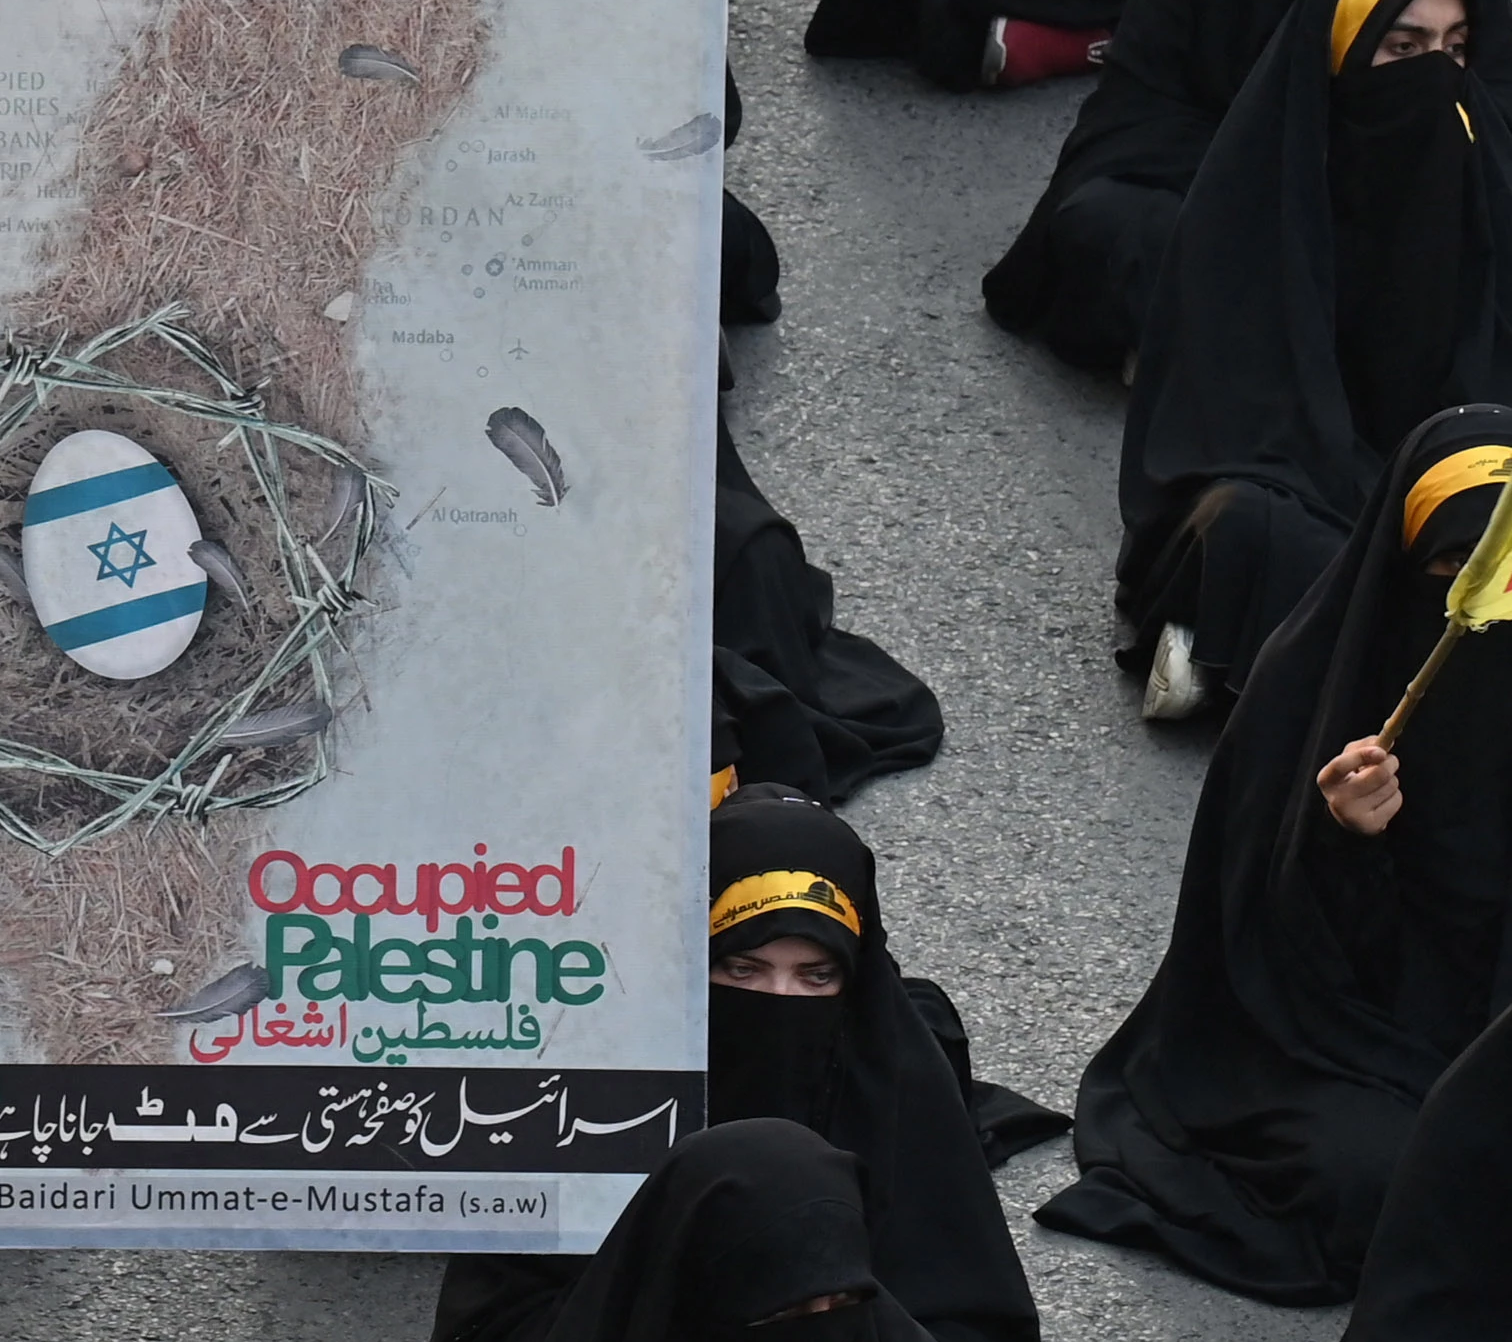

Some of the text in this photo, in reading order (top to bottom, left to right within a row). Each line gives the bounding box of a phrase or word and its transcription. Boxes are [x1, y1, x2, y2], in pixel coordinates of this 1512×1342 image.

[487, 147, 536, 164] Jarash
[16, 218, 49, 233] Aviv
[392, 330, 455, 345] Madaba
[432, 508, 518, 525] Al Qatranah
[248, 842, 576, 934] Occupied
[266, 912, 606, 1006] Palestine
[238, 1112, 299, 1144] سے
[397, 1091, 436, 1146] کو
[419, 1074, 678, 1157] اسرائیل
[131, 1183, 446, 1215] Ummat-e-Mustafa
[459, 1191, 549, 1219] (s.a.w)
